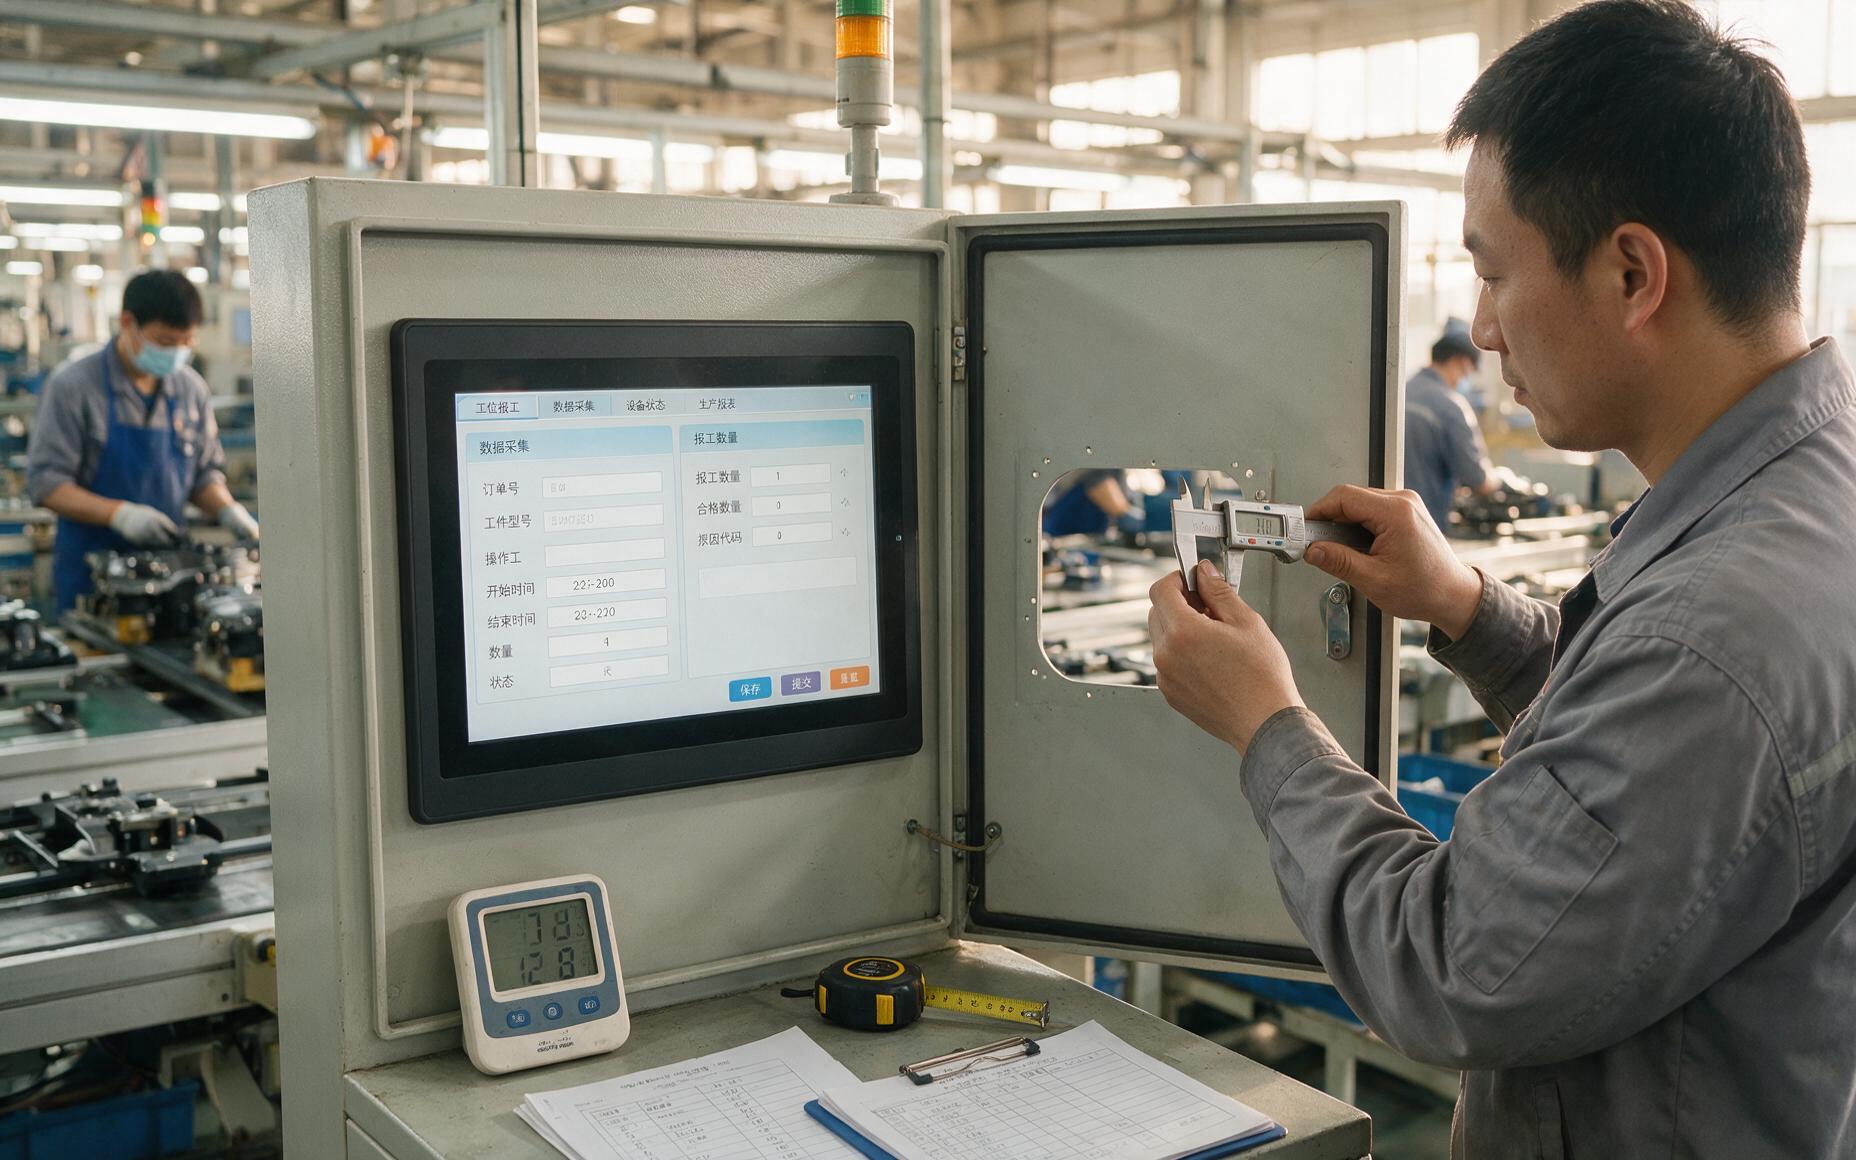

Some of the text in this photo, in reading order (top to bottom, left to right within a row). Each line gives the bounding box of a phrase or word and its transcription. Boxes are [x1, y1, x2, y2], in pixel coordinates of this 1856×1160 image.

[475, 400, 520, 415] 工位报工
[553, 399, 596, 413] 数据采集
[626, 398, 666, 411] 设备状态
[479, 438, 530, 456] 数据采集
[693, 432, 738, 446] 报工数量
[695, 469, 741, 485] 报工数量
[482, 481, 520, 496] 订单号
[696, 499, 742, 516] 合格数量
[484, 514, 532, 531] 工件型号
[484, 551, 522, 567] 操作工
[486, 582, 535, 599] 开始时间
[487, 612, 537, 630] 结束时间
[488, 644, 513, 661] 数量
[489, 674, 515, 691] 状态
[740, 683, 761, 698] 保存
